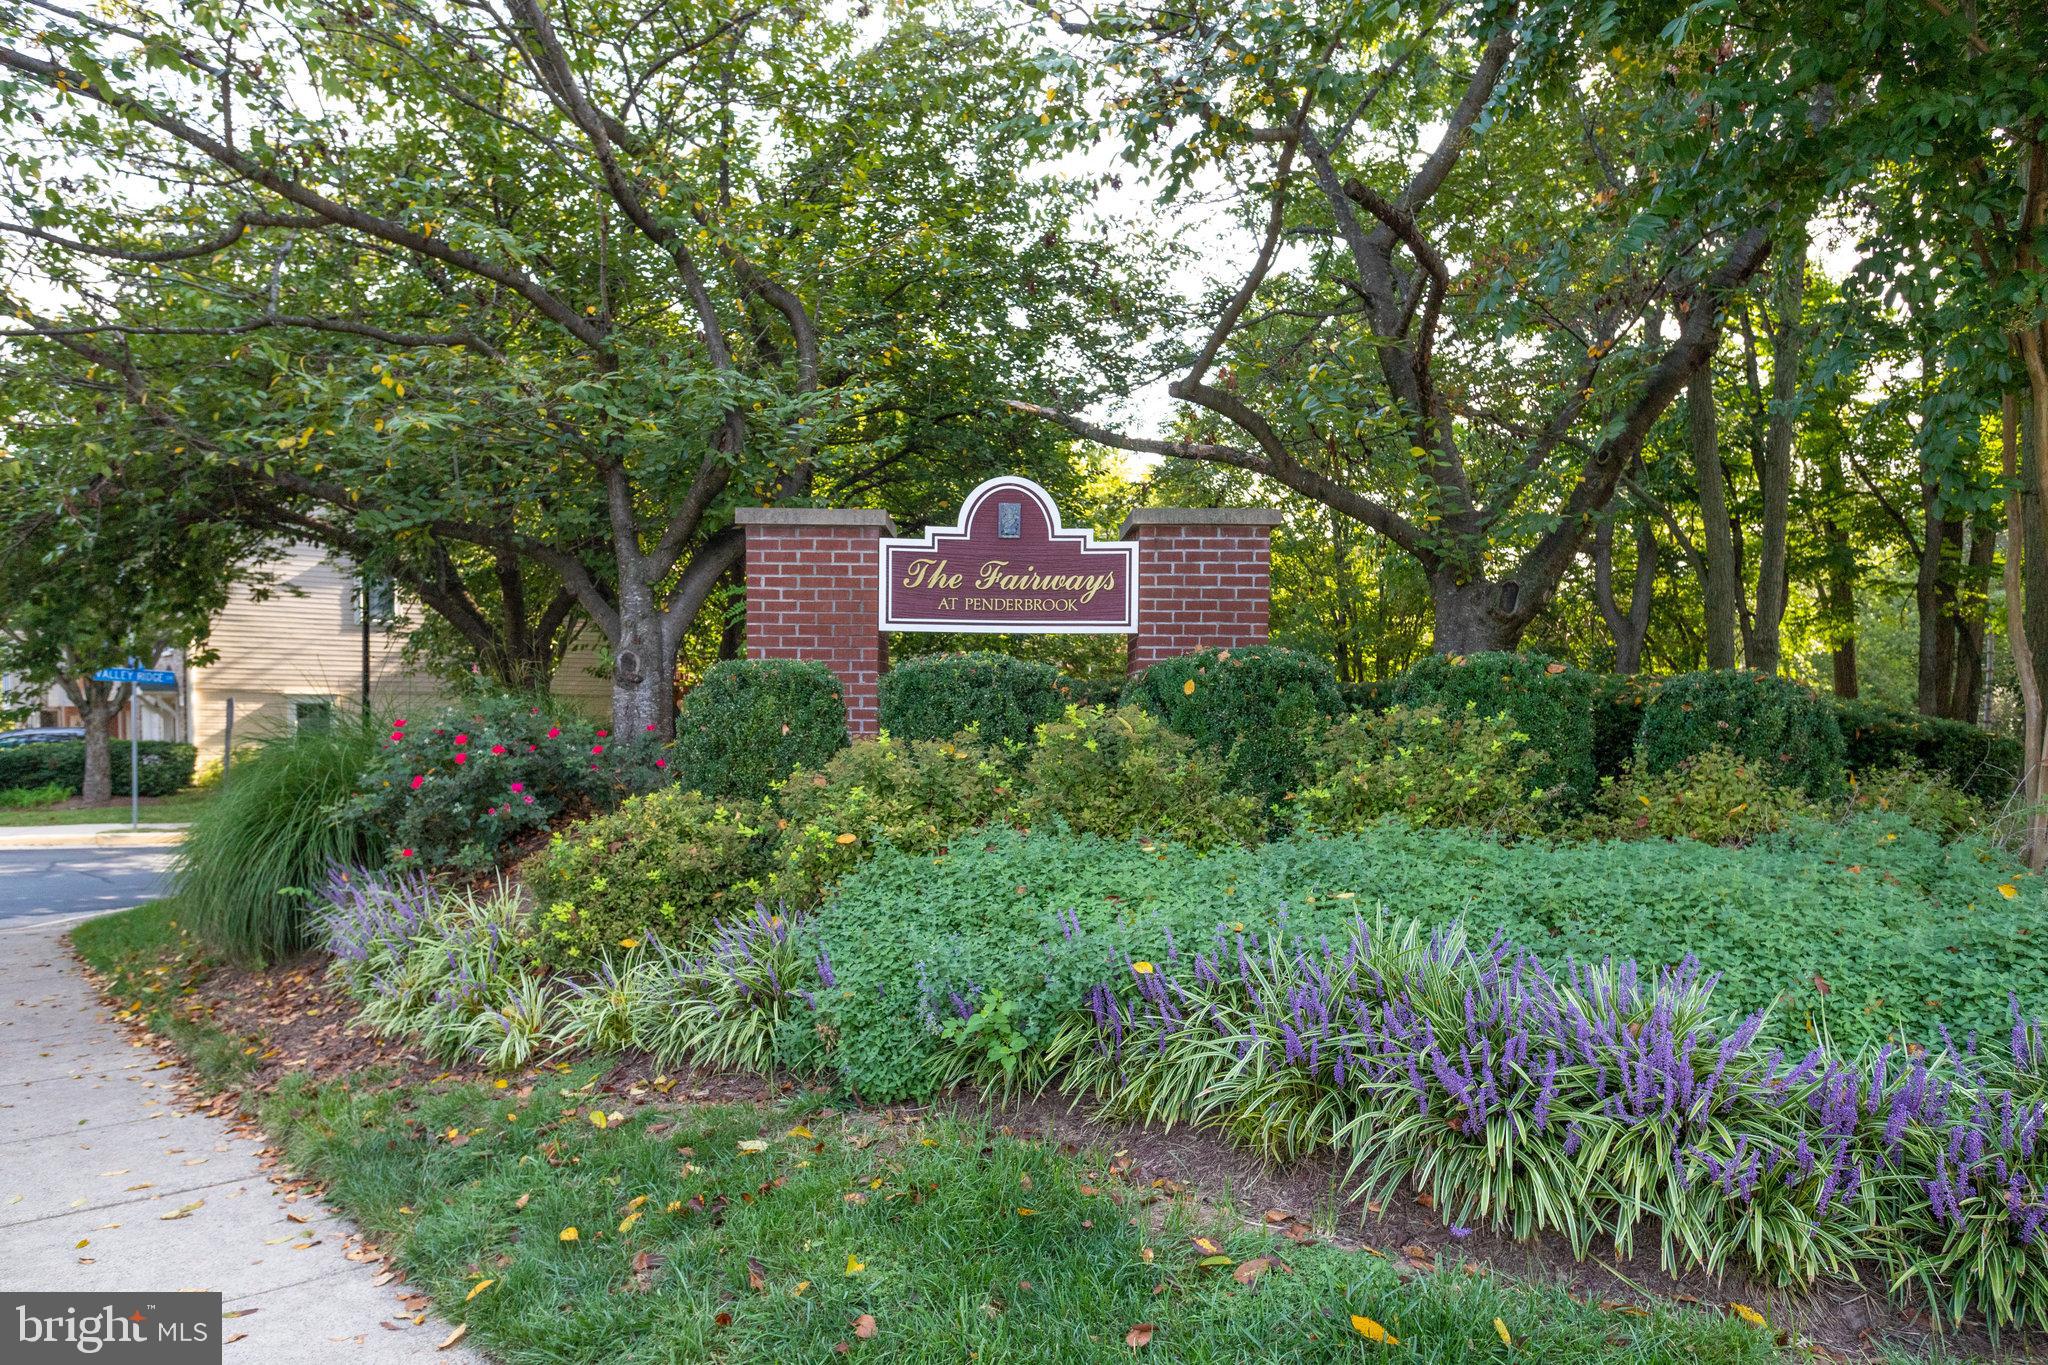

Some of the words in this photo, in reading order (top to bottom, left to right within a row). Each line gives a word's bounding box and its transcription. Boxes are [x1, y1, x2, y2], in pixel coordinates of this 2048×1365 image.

[903, 558, 963, 589] The
[974, 560, 1115, 604] Fairways
[937, 597, 959, 611] AT
[965, 598, 1078, 612] PENDERBROOK
[96, 669, 134, 680] VALLEY
[136, 672, 163, 682] RIDGE
